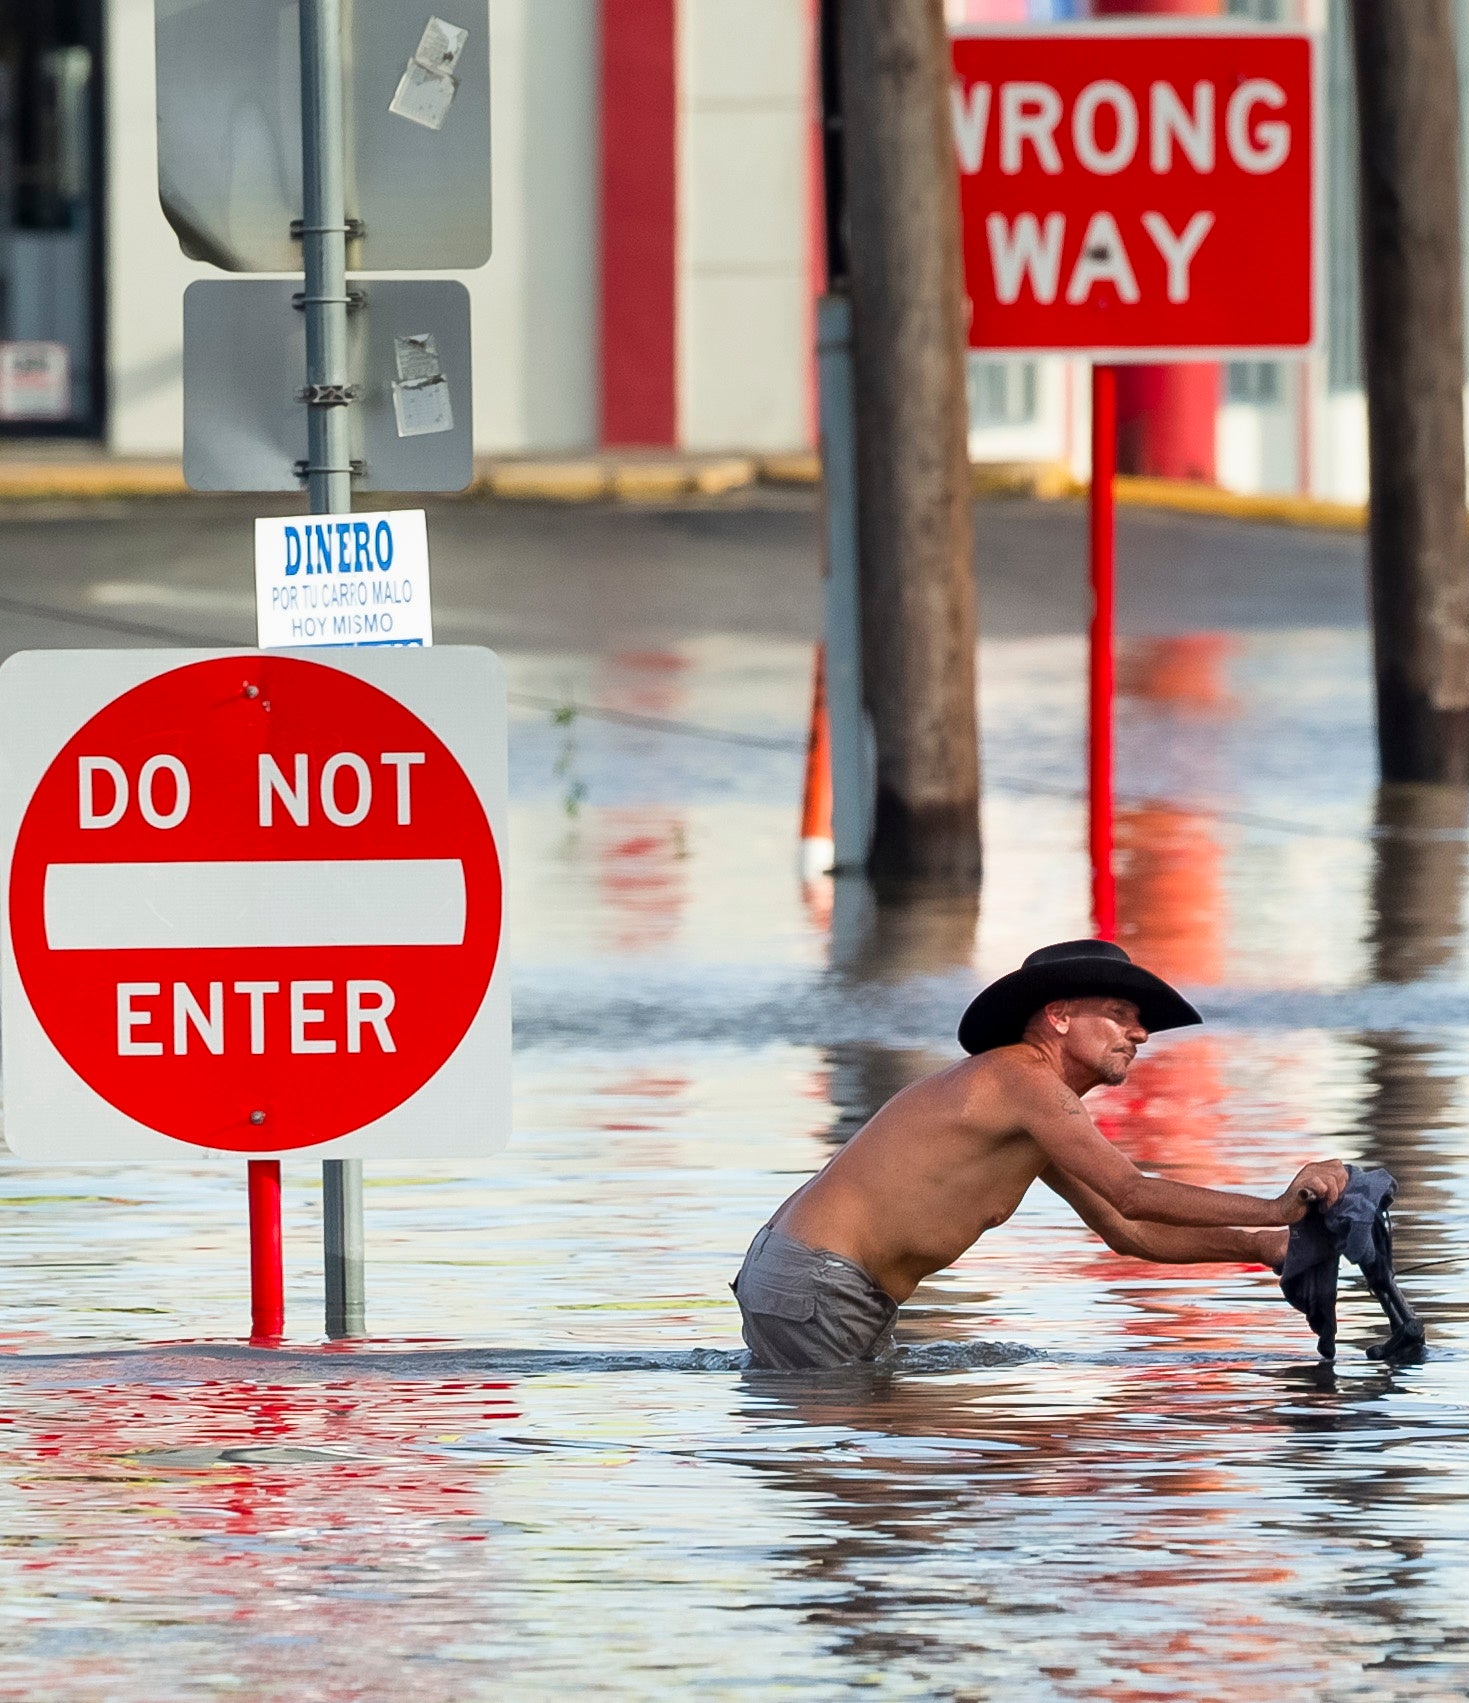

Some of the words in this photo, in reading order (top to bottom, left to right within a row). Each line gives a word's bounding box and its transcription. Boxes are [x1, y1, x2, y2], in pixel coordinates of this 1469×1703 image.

[986, 212, 1214, 304] WAY
[284, 520, 393, 576] DINERO
[272, 585, 299, 610] POR
[302, 584, 317, 609] TU
[322, 581, 367, 608] CARRO
[372, 579, 412, 605] MALO
[292, 617, 327, 637] HOY
[333, 613, 393, 634] MISMO
[79, 754, 191, 829] DO
[258, 752, 426, 827] NOT
[117, 979, 397, 1056] ENTER
